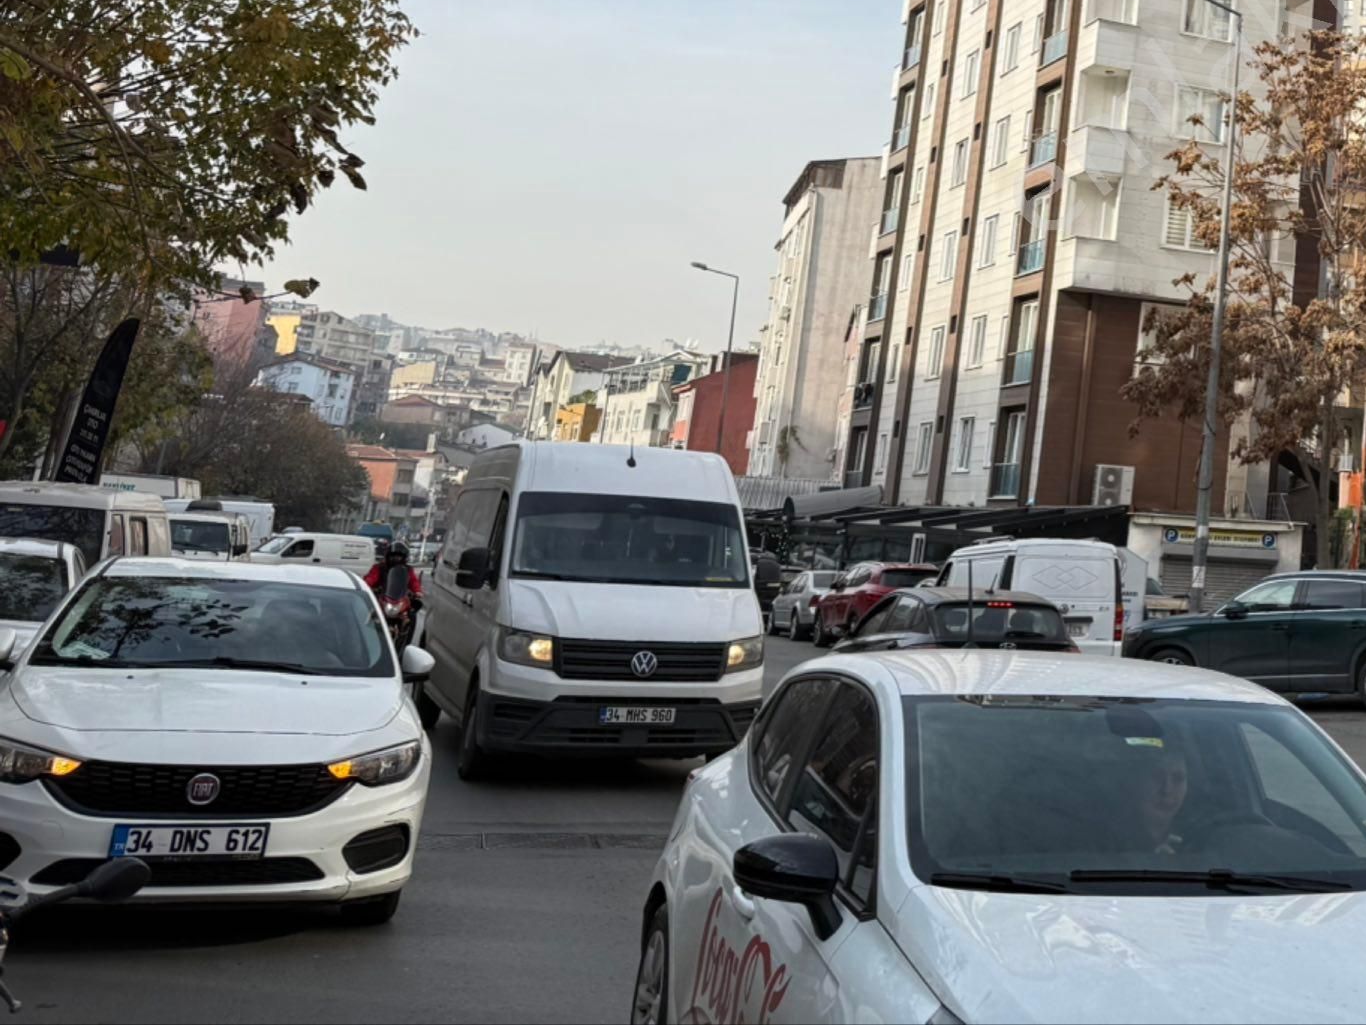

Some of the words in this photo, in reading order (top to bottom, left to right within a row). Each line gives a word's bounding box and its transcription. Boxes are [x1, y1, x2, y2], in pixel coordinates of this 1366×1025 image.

[606, 708, 620, 722] 34
[193, 782, 214, 797] FIAT
[126, 830, 154, 853] 34
[169, 829, 212, 853] DNS
[225, 829, 263, 852] 612
